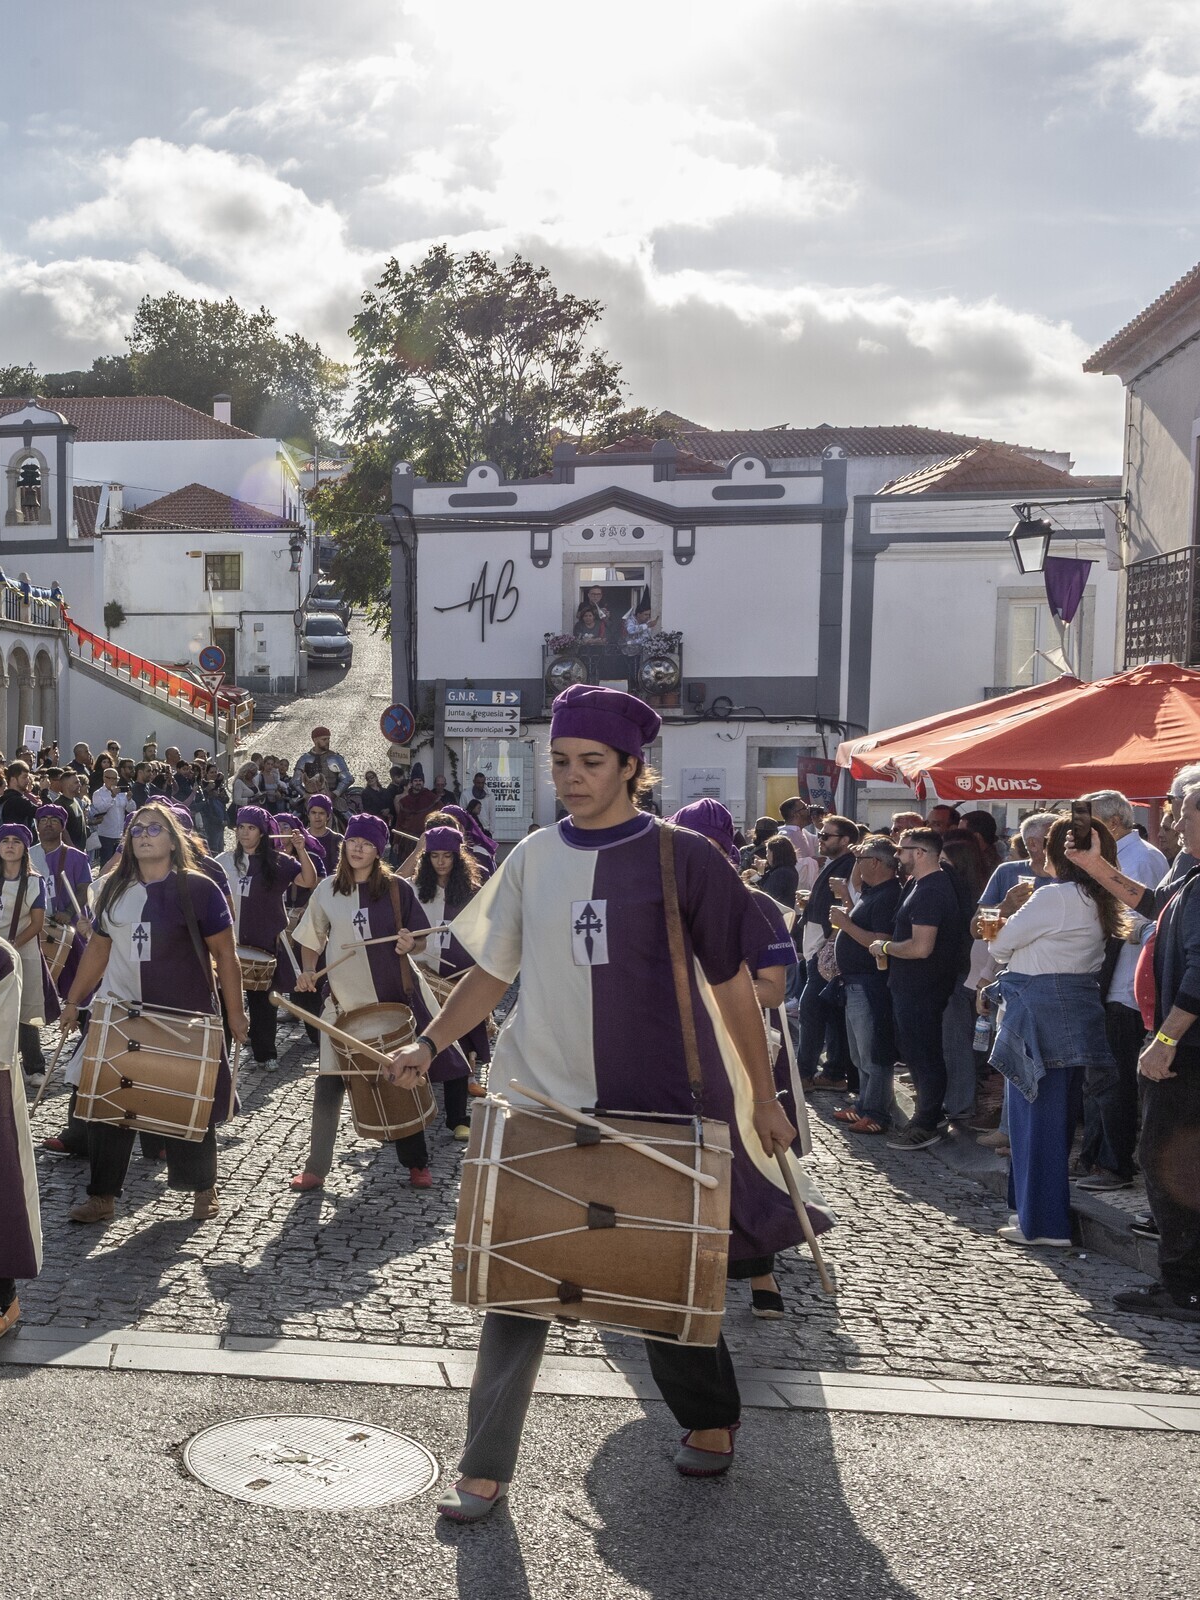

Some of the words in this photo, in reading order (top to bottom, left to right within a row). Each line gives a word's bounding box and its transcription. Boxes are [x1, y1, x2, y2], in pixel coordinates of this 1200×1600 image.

[448, 691, 478, 701] G.N.R.
[448, 709, 465, 717] Junta
[473, 709, 504, 719] freguesia
[474, 726, 504, 734] municipal
[975, 774, 1042, 793] SAGRES
